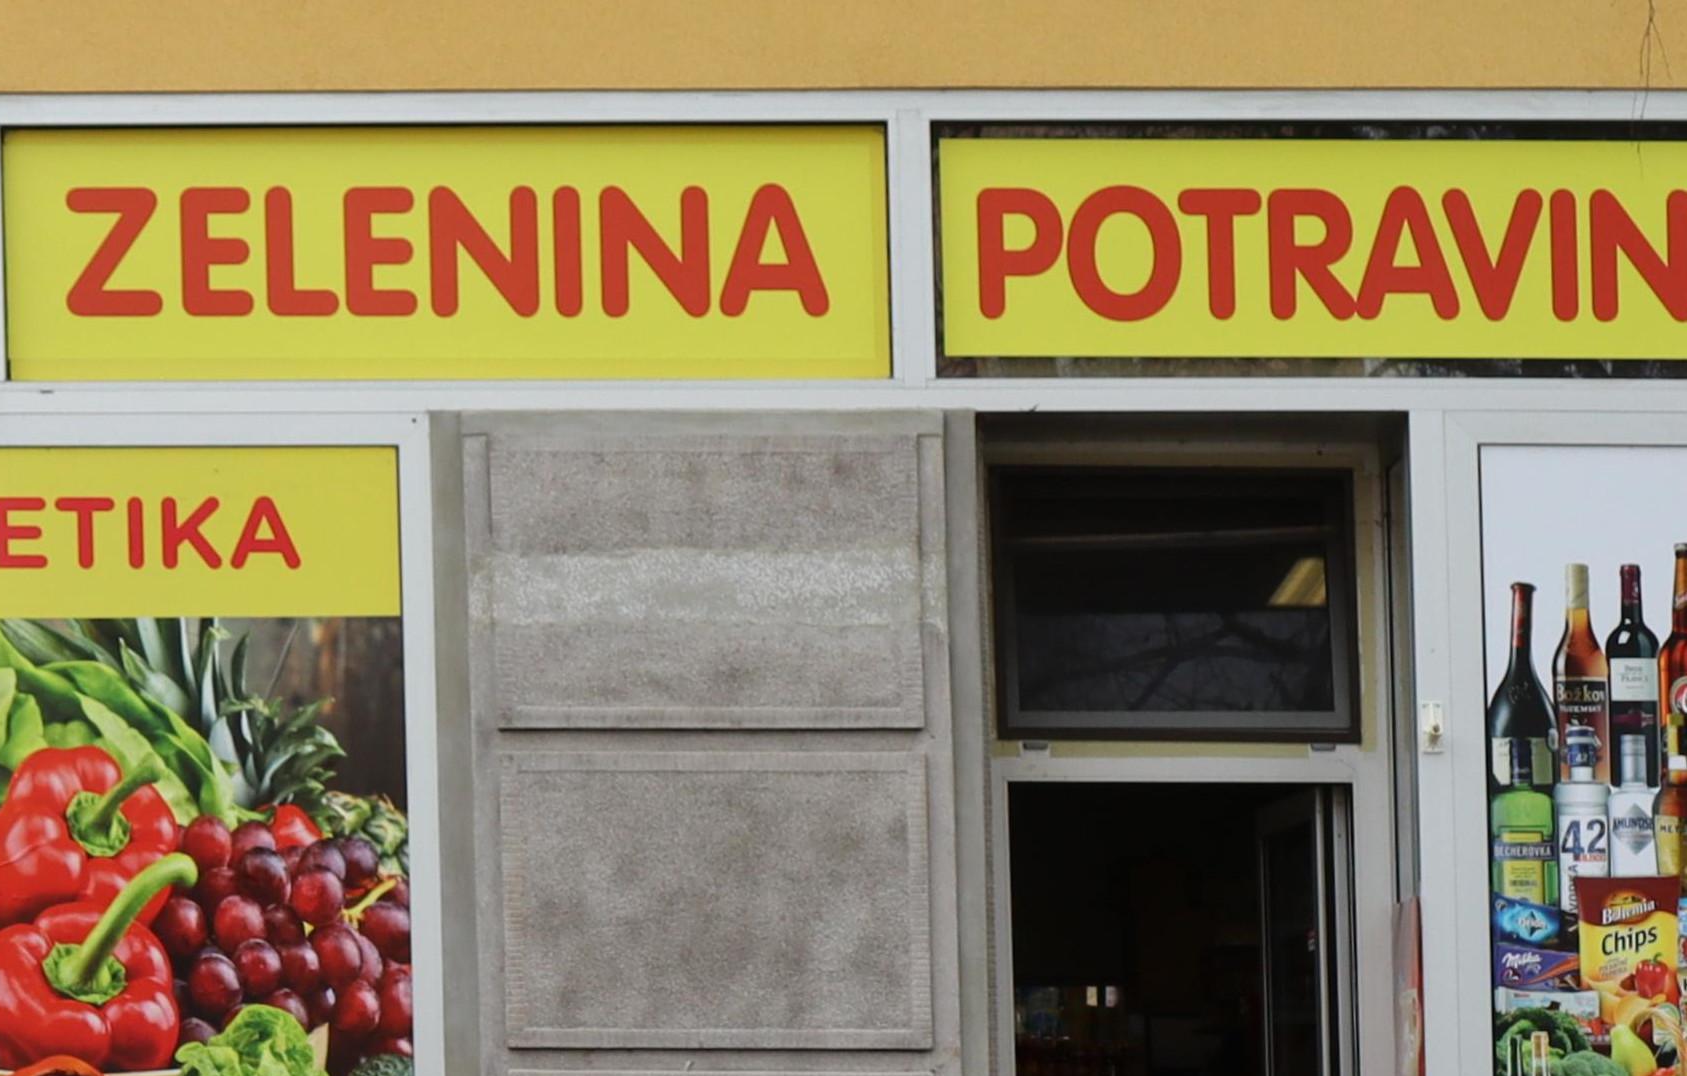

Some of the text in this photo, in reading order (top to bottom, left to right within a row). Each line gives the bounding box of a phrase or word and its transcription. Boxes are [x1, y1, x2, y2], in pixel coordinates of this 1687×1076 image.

[66, 184, 830, 317] ZELENINA
[976, 185, 1687, 323] POTRAVIN
[1561, 819, 1606, 861] 42
[1602, 900, 1656, 925] Bohemia
[1602, 926, 1657, 955] Chips
